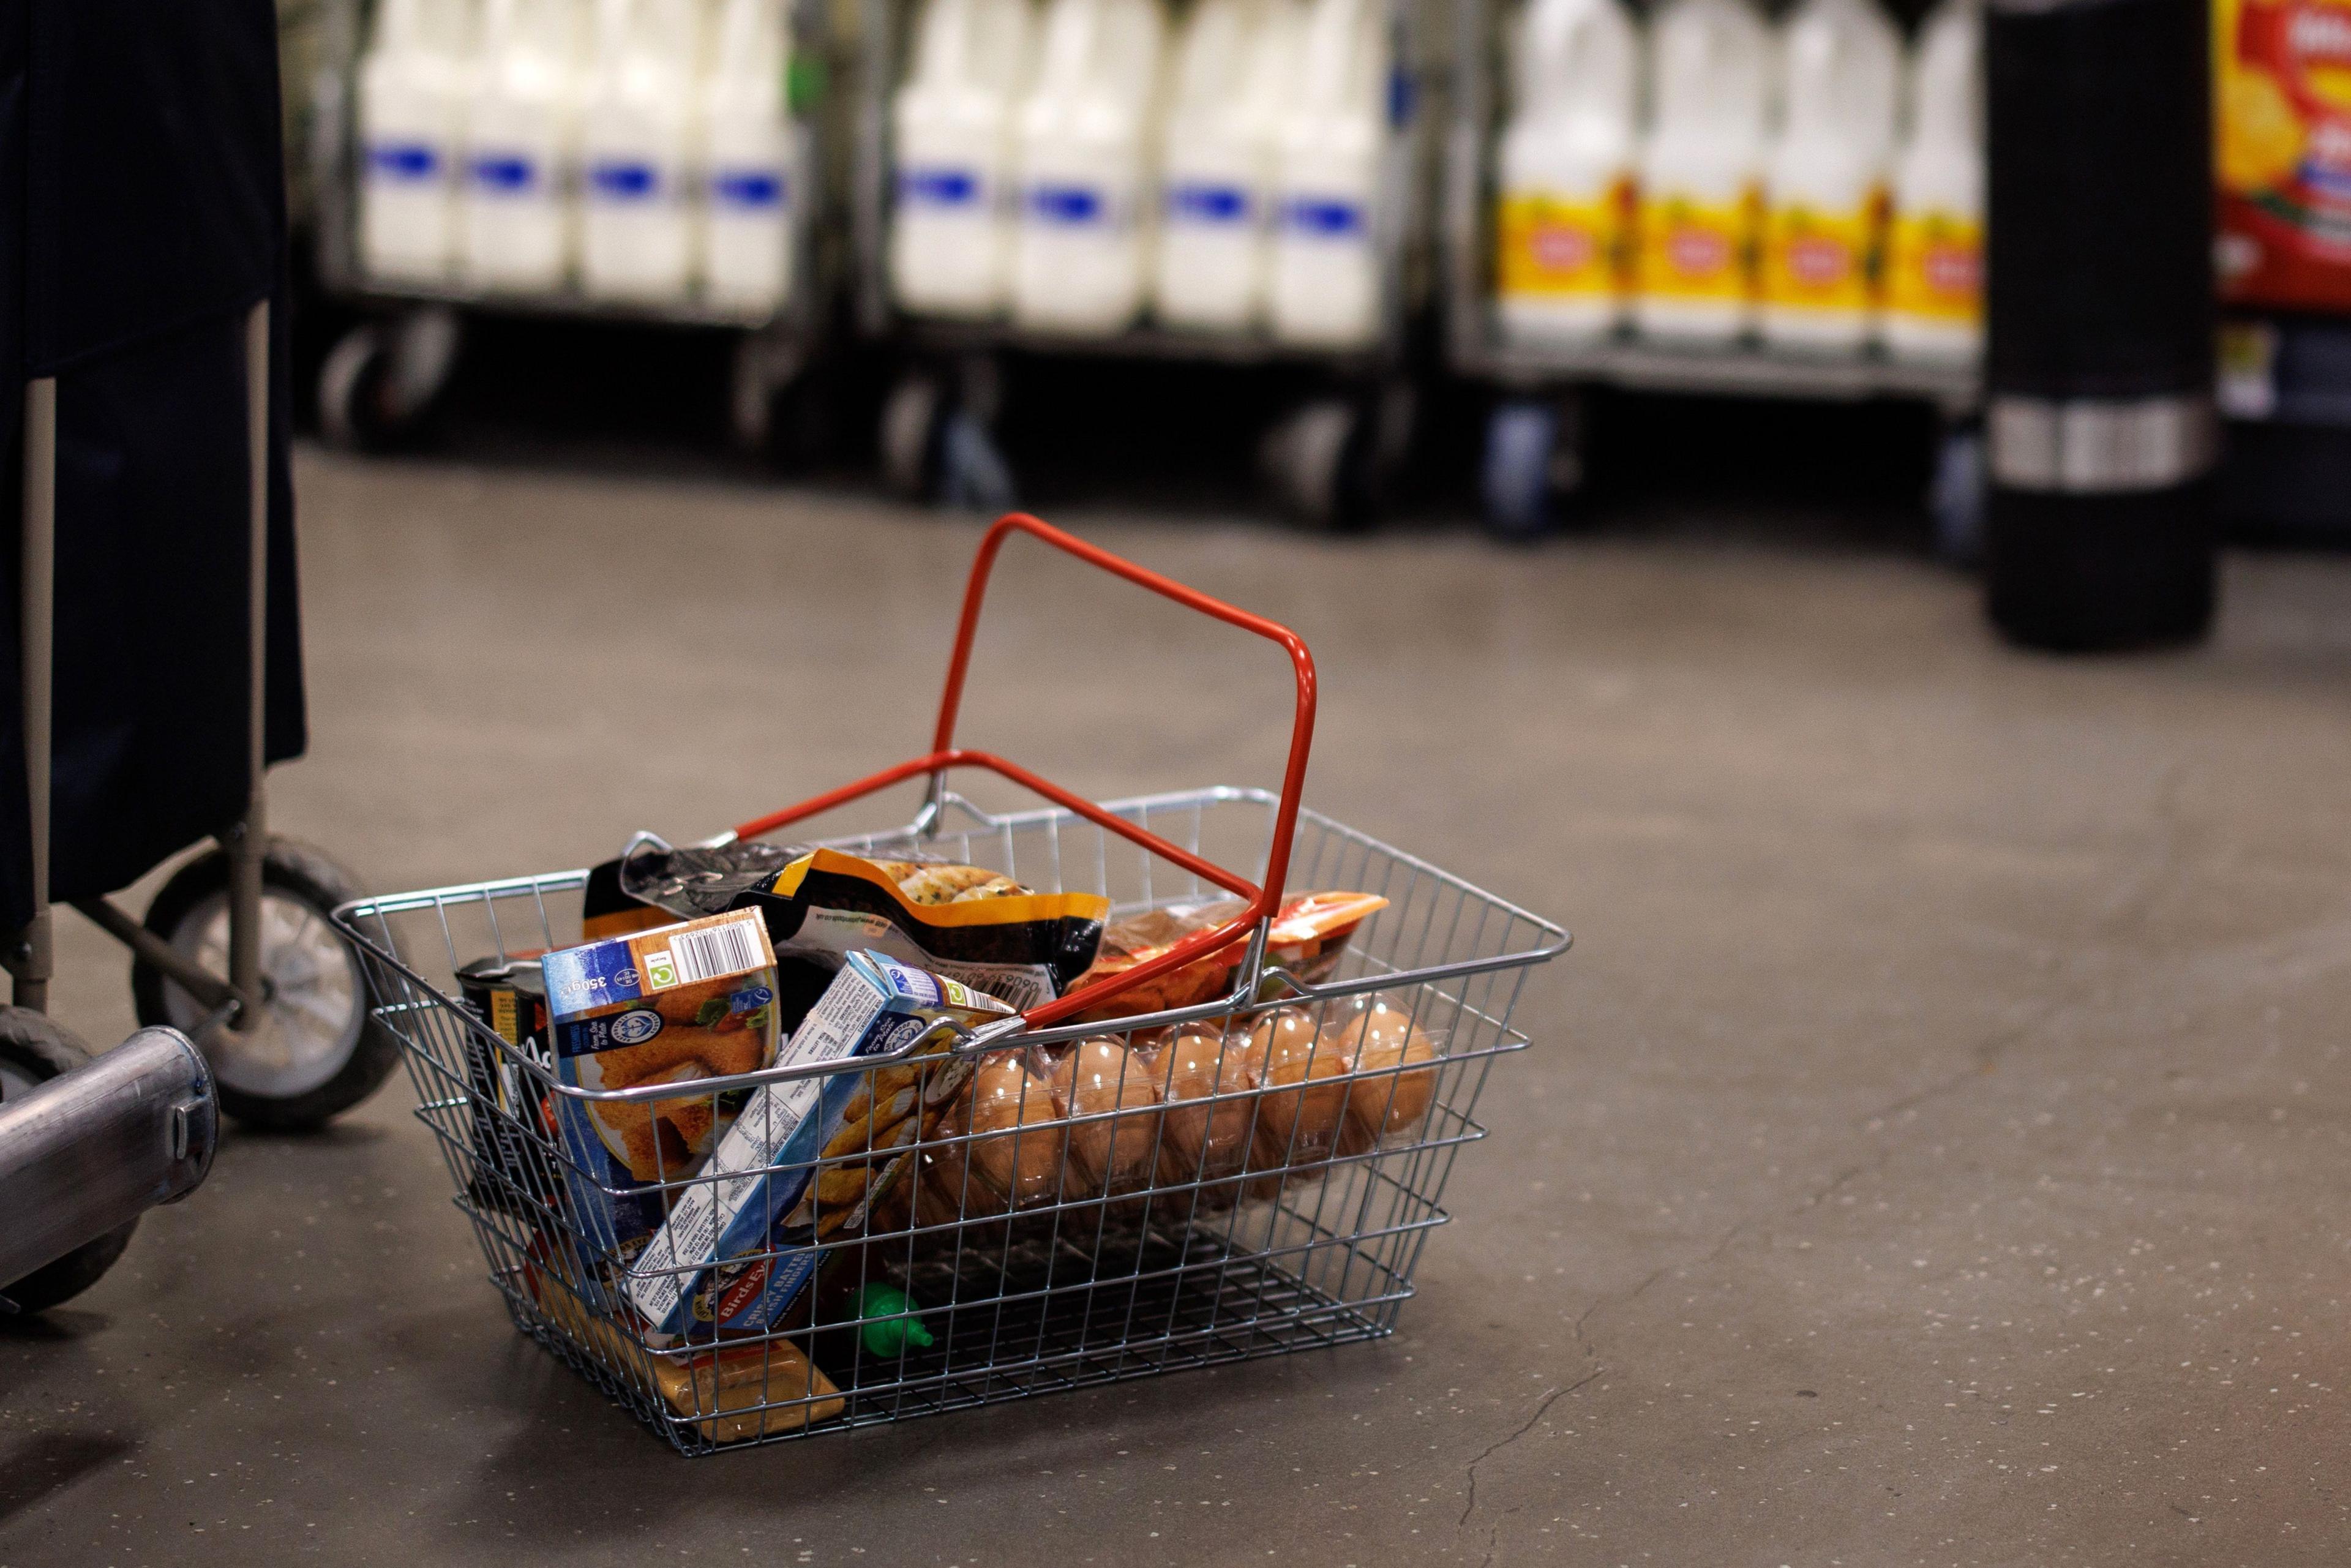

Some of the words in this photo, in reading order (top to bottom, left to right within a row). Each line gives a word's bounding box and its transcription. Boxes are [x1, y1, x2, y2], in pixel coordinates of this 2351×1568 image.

[571, 976, 607, 992] 350g
[872, 997, 883, 1010] OUR
[857, 1005, 877, 1034] INGREDIENTS
[782, 1119, 800, 1141] NUTRITION
[767, 1293, 782, 1316] ISH
[781, 1252, 814, 1293] FINGERS
[721, 1279, 754, 1318] Birds
